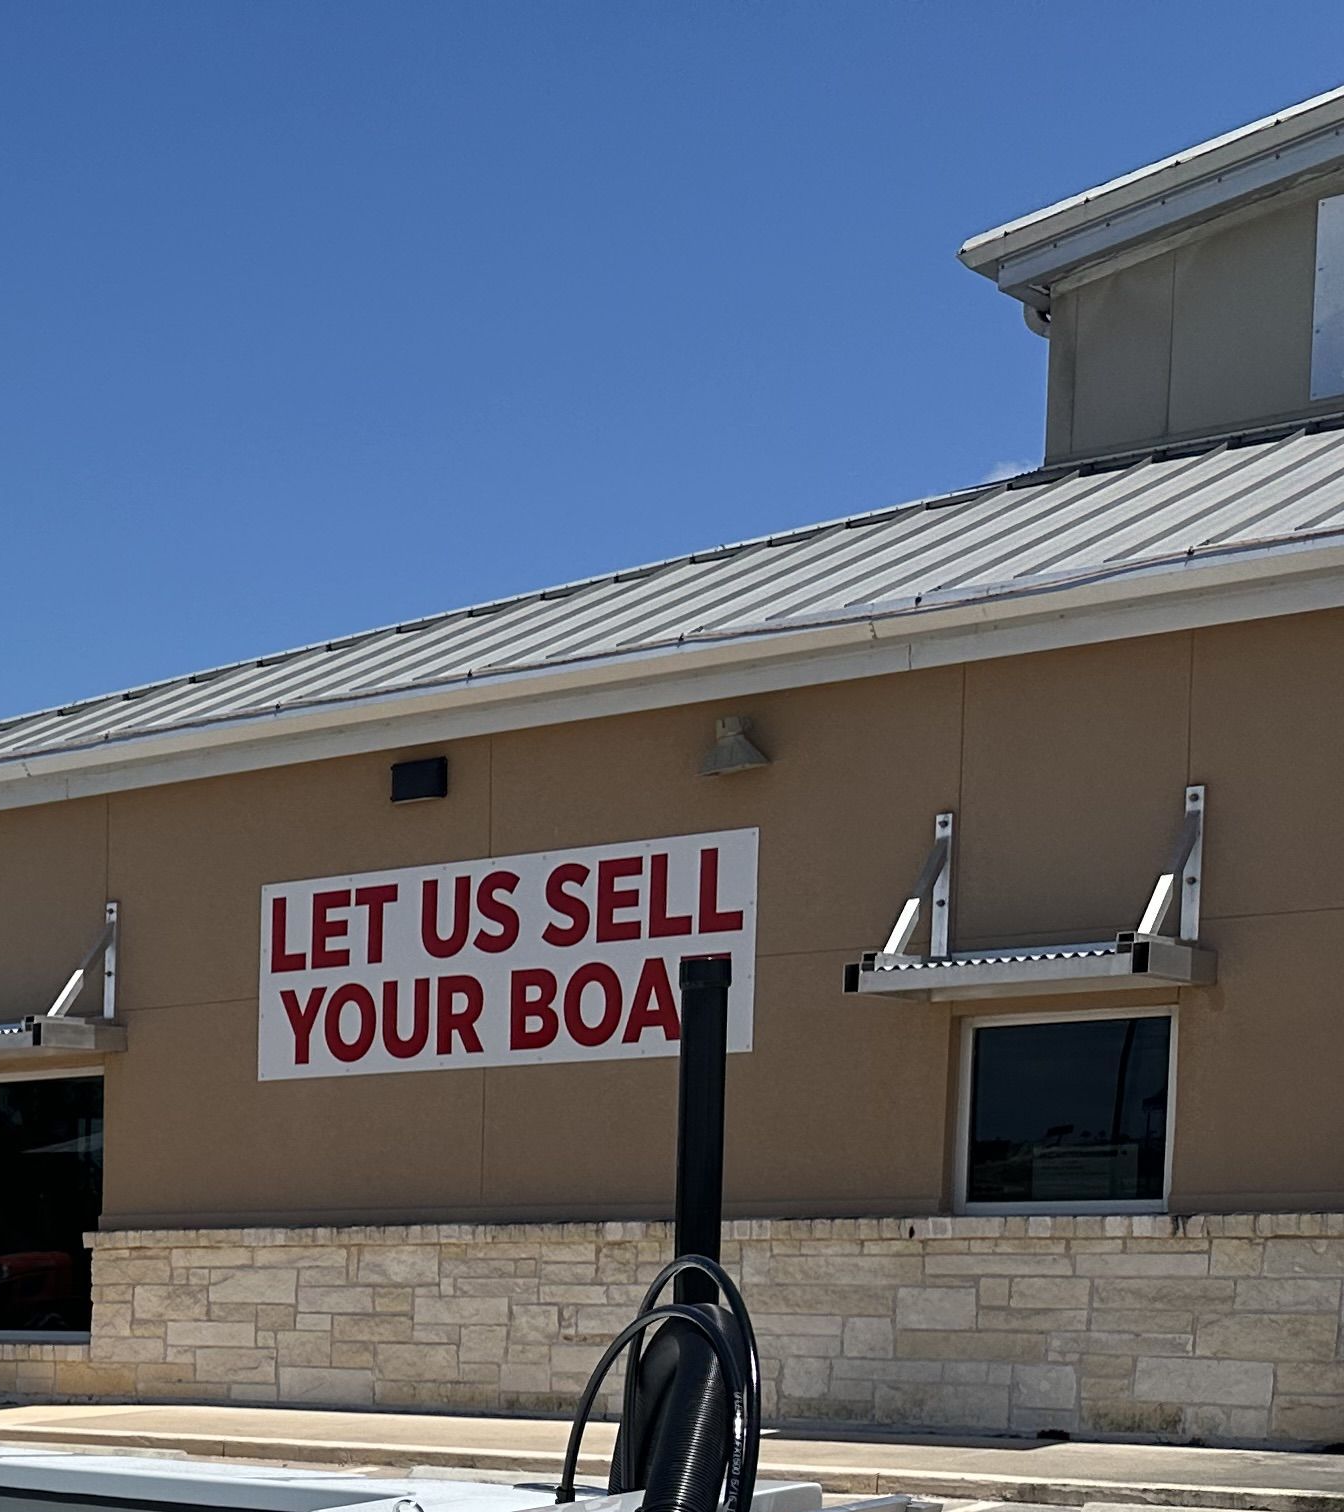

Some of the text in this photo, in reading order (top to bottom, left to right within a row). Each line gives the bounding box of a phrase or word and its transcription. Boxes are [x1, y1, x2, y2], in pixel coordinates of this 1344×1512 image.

[270, 847, 744, 974] LET US SELL
[279, 953, 732, 1066] YOUR BOA
